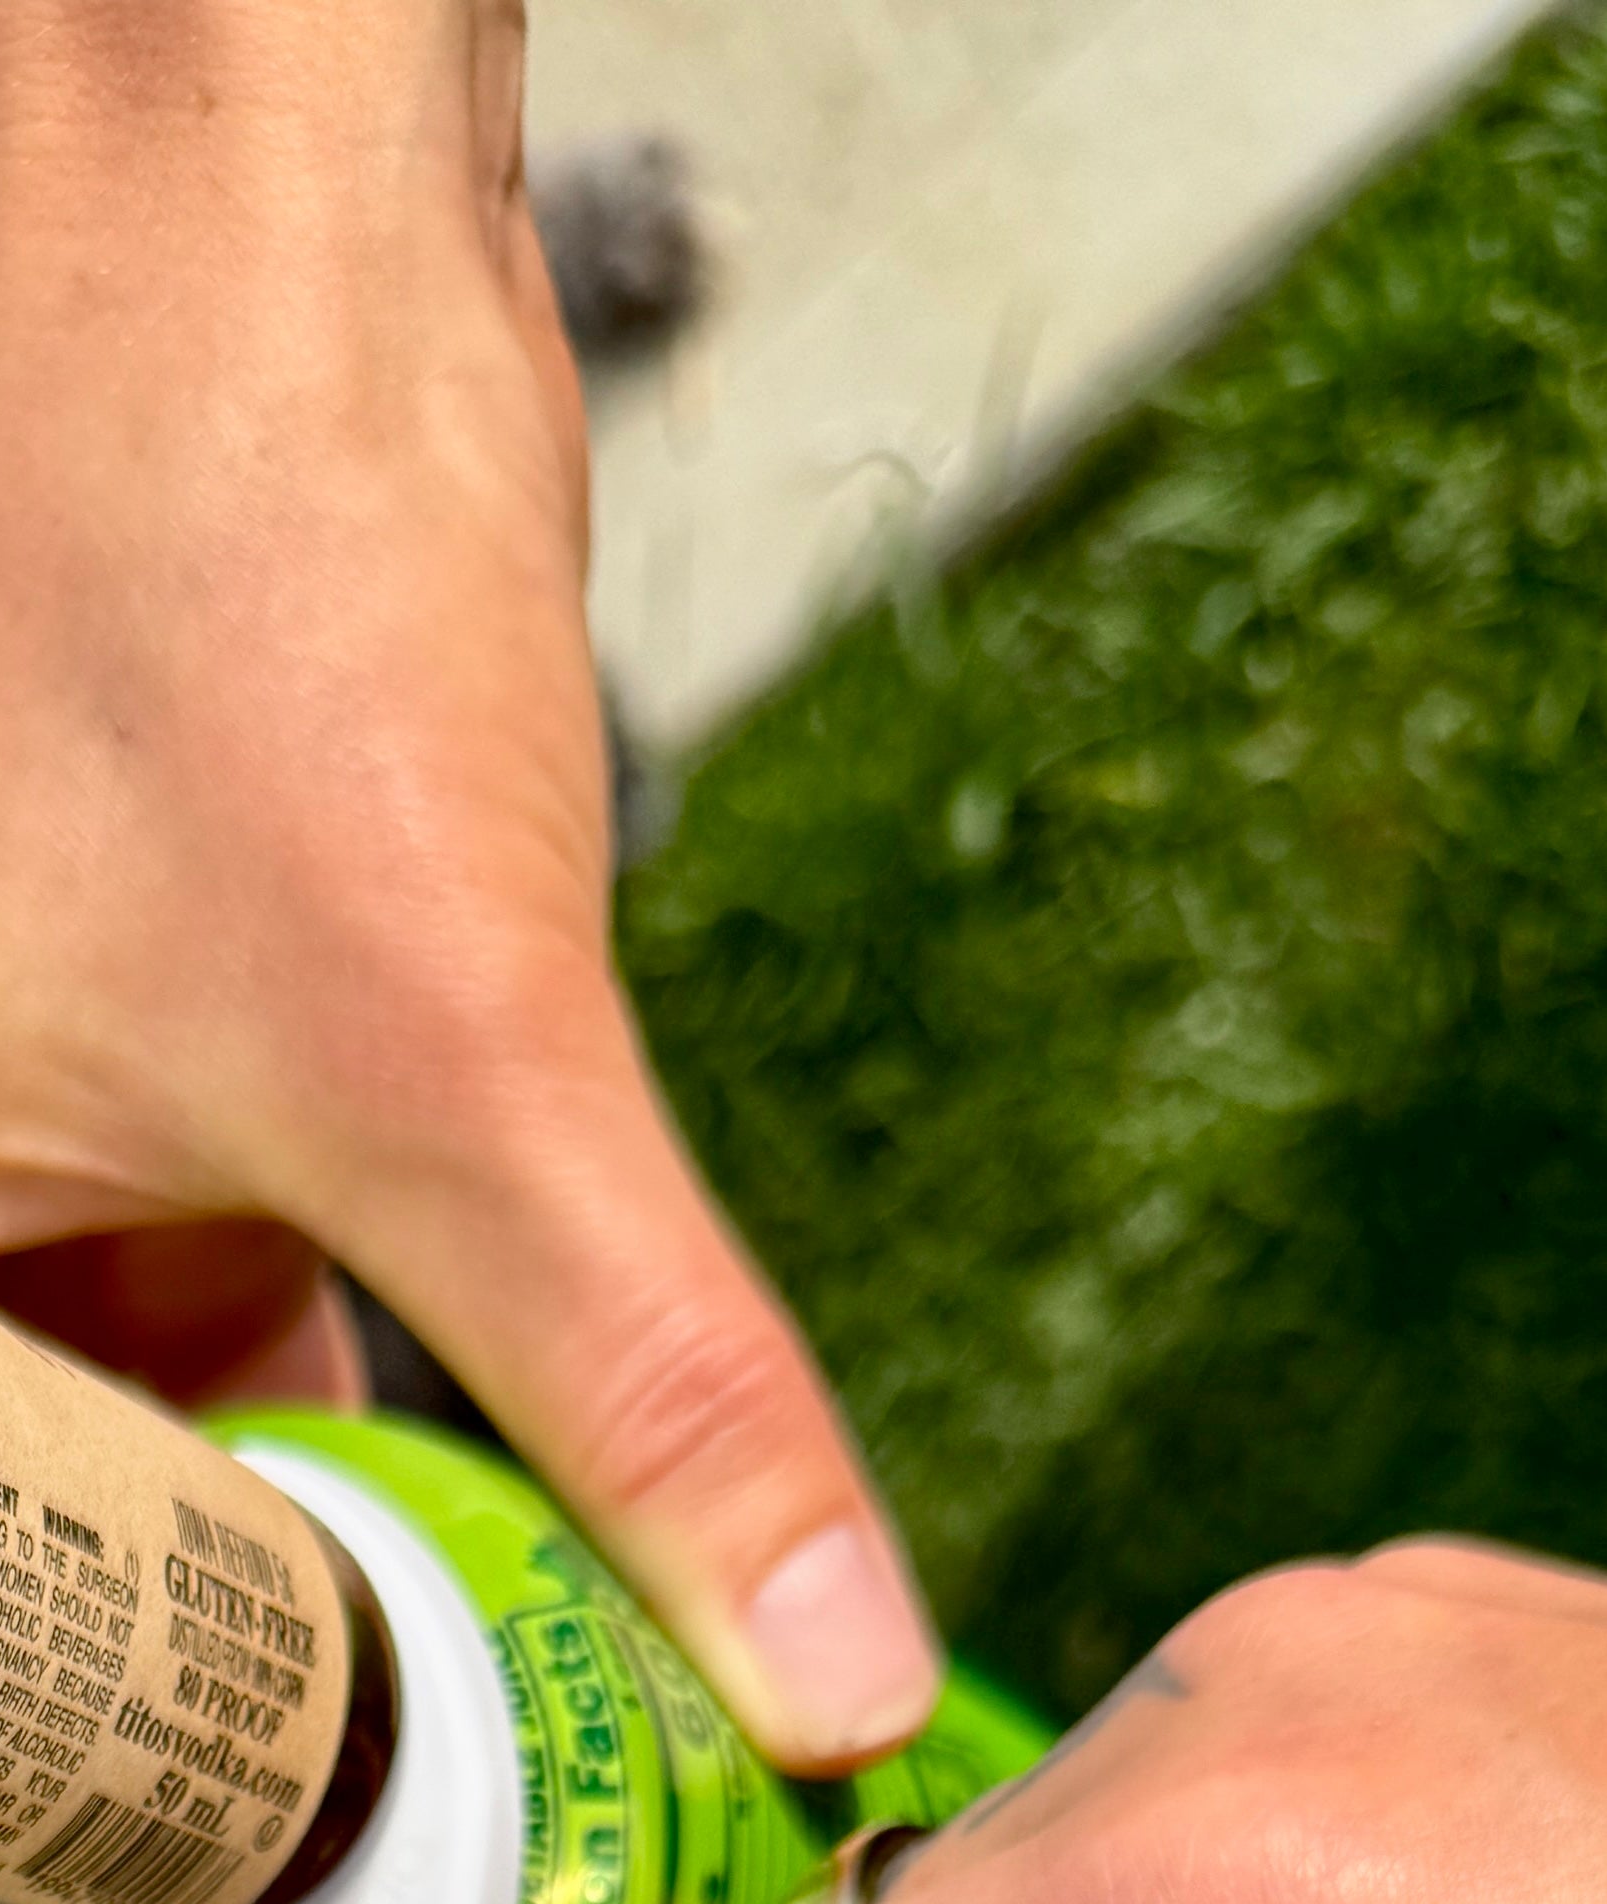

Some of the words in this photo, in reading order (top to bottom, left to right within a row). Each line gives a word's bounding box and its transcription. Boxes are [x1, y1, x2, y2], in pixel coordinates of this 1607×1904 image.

[42, 1503, 105, 1562] WARNING:
[16, 1528, 34, 1562] TO
[42, 1542, 67, 1579] THE
[76, 1561, 140, 1616] SURGEON
[49, 1584, 102, 1634] SHOULD
[106, 1618, 136, 1648] NOT
[164, 1552, 317, 1668] GLUTEN-FREE
[48, 1624, 127, 1684] BEVERAGES
[52, 1666, 117, 1716] BECAUSE
[172, 1664, 204, 1713] 80
[201, 1677, 287, 1747] PROOF
[542, 1617, 618, 1799] Facts
[7, 1727, 87, 1776] ALCOHOLIC
[35, 1699, 101, 1747] DEFECTS.
[114, 1696, 304, 1813] titosvodka.com
[17, 1804, 48, 1829] OR
[24, 1769, 68, 1803] YOUR
[143, 1769, 191, 1817] 50
[182, 1797, 238, 1839] mL
